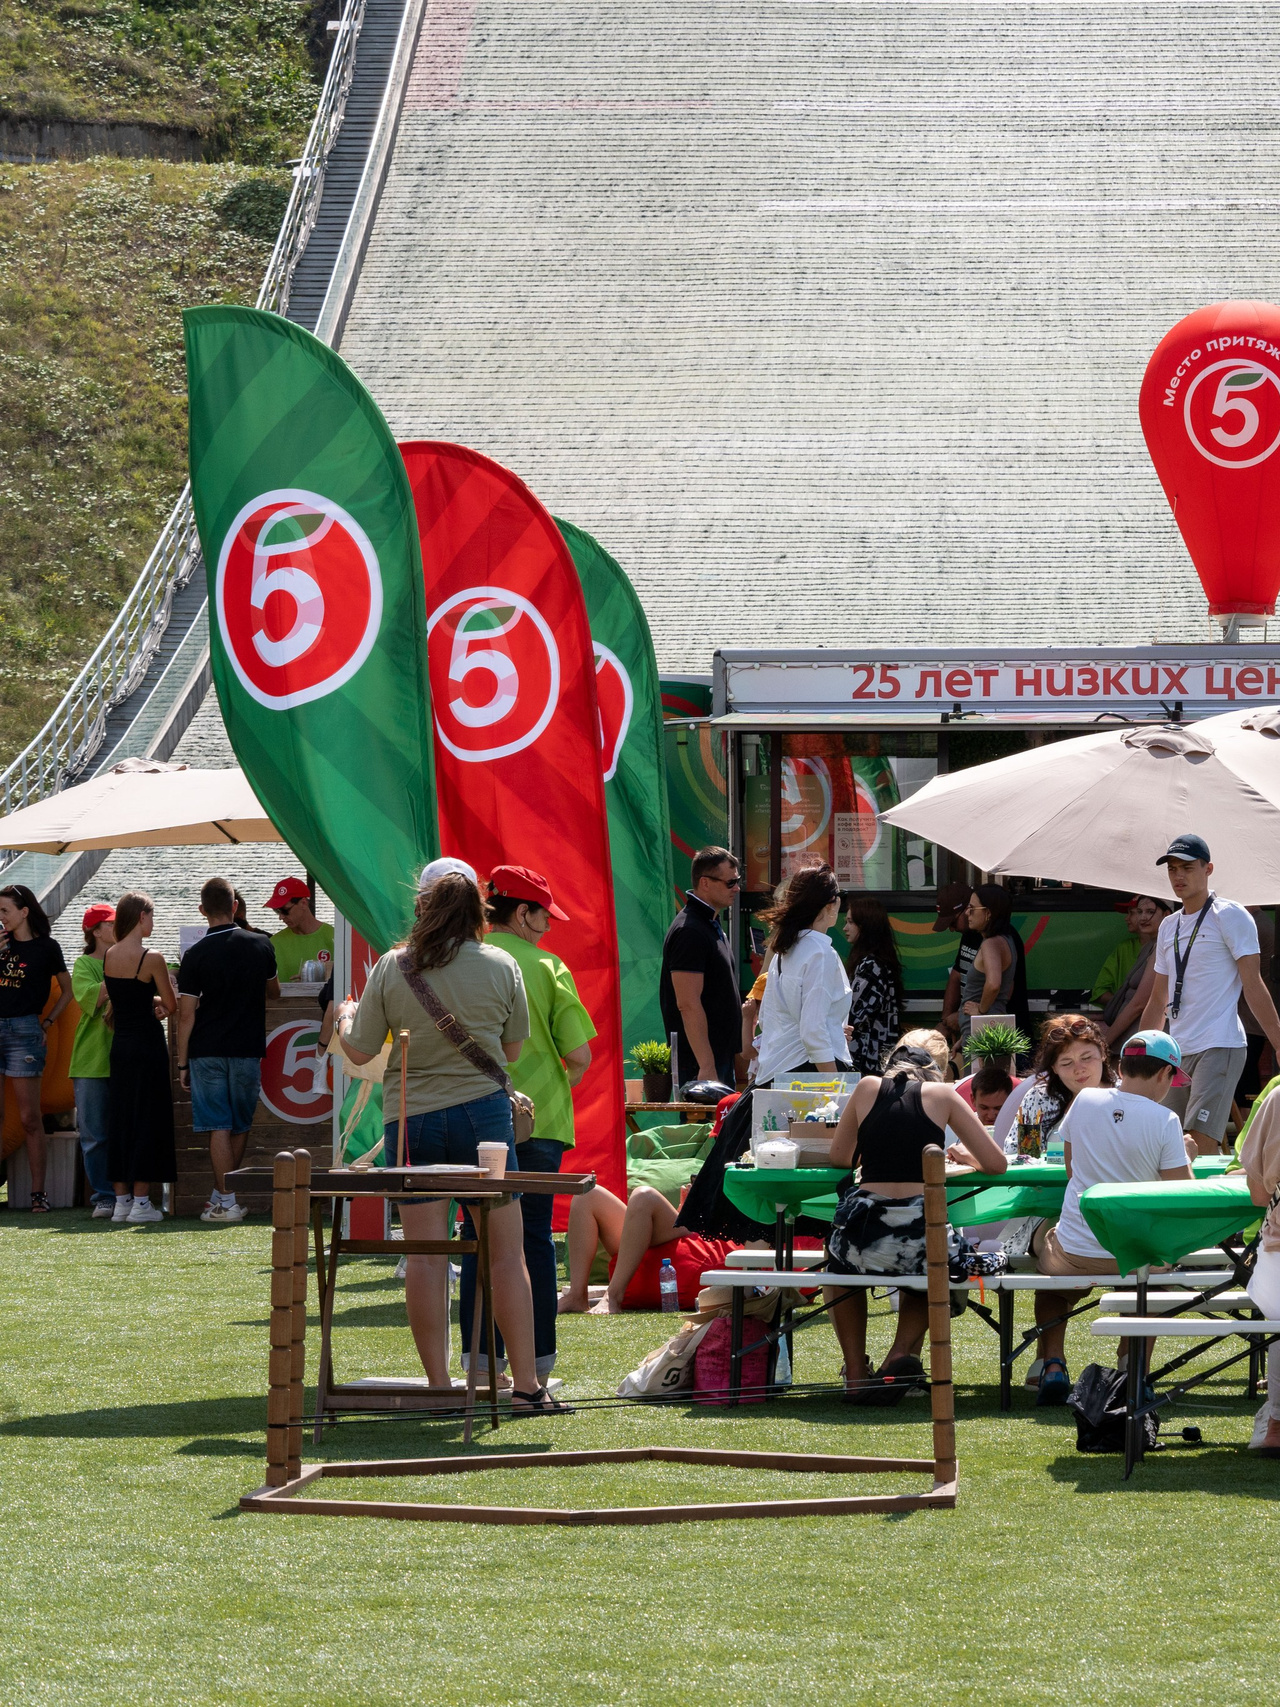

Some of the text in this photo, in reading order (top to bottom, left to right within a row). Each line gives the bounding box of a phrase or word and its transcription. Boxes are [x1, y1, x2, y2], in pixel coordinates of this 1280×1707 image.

[1163, 348, 1202, 407] Место
[1210, 368, 1269, 447] 5
[250, 504, 334, 667] 5
[448, 599, 525, 728] 5
[852, 664, 901, 699] 25
[915, 667, 999, 698] лет
[1015, 666, 1190, 697] низких
[282, 1028, 322, 1104] 5
